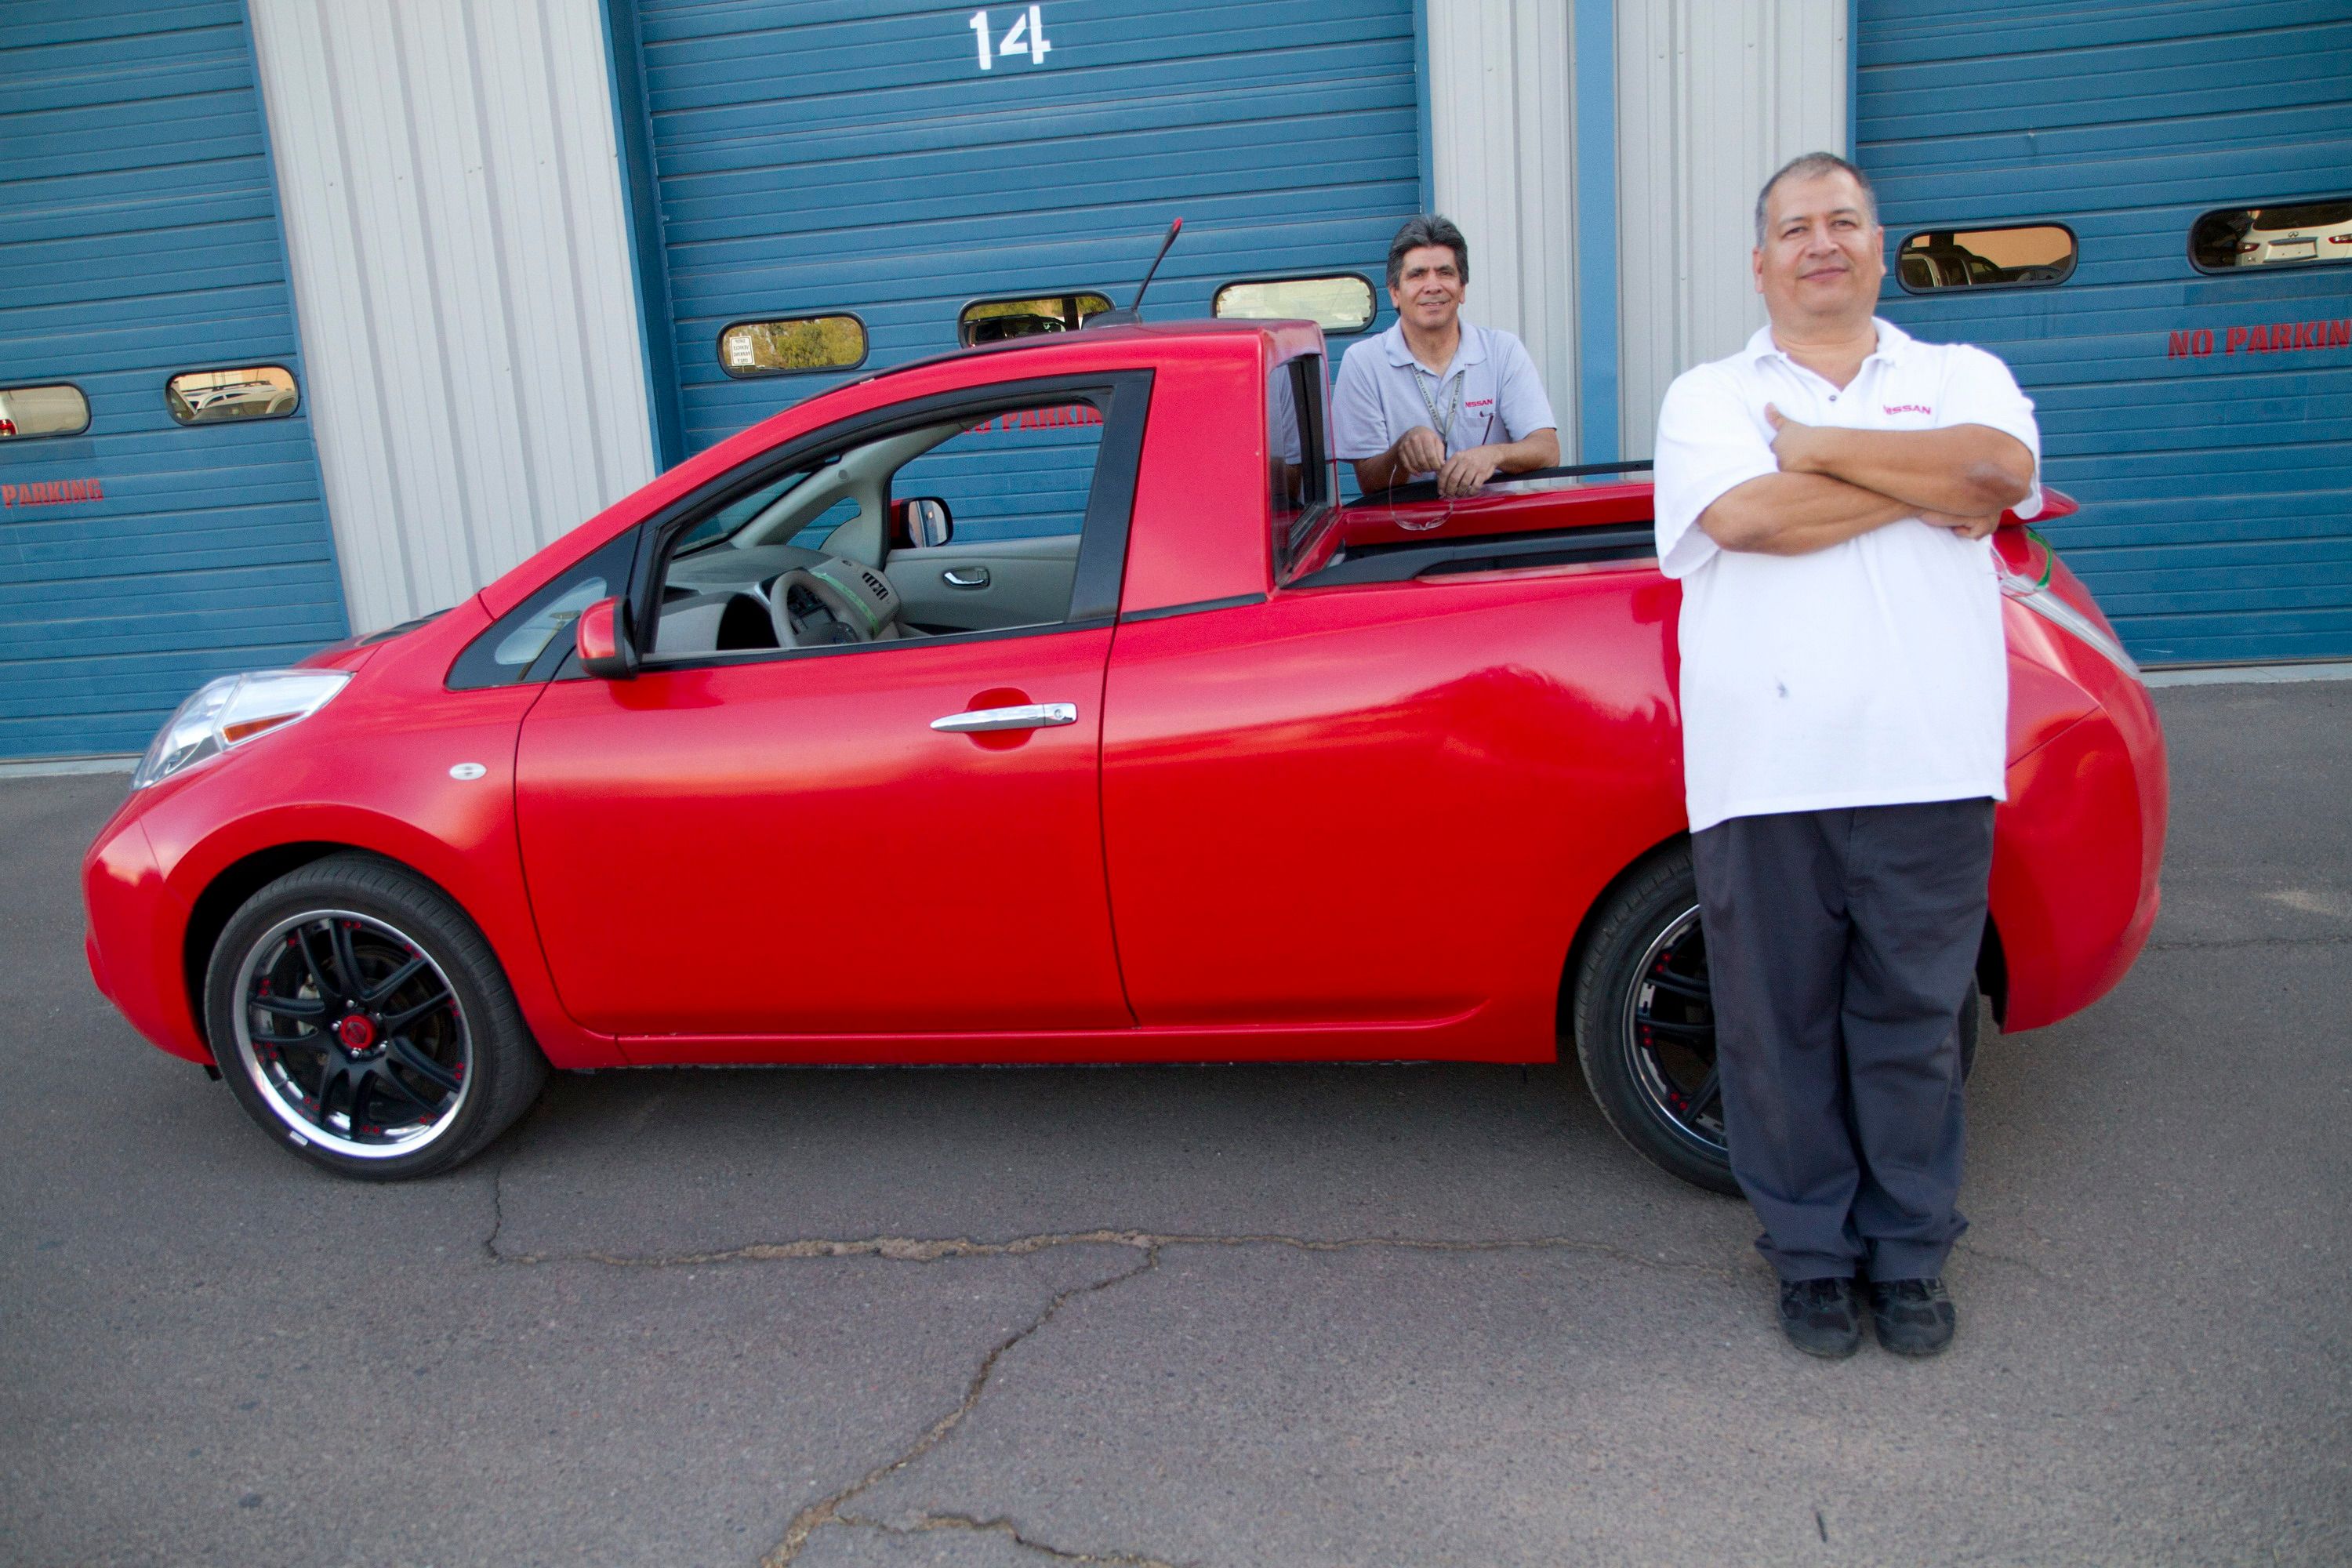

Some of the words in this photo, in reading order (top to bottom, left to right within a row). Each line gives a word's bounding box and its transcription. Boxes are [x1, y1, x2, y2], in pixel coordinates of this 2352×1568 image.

[970, 5, 1051, 70] 14
[2168, 330, 2214, 360] NO
[2225, 319, 2350, 356] PARKIN
[1465, 398, 1493, 408] NISSAN
[1883, 405, 1931, 415] NISSAN
[2, 478, 103, 508] PARKING
